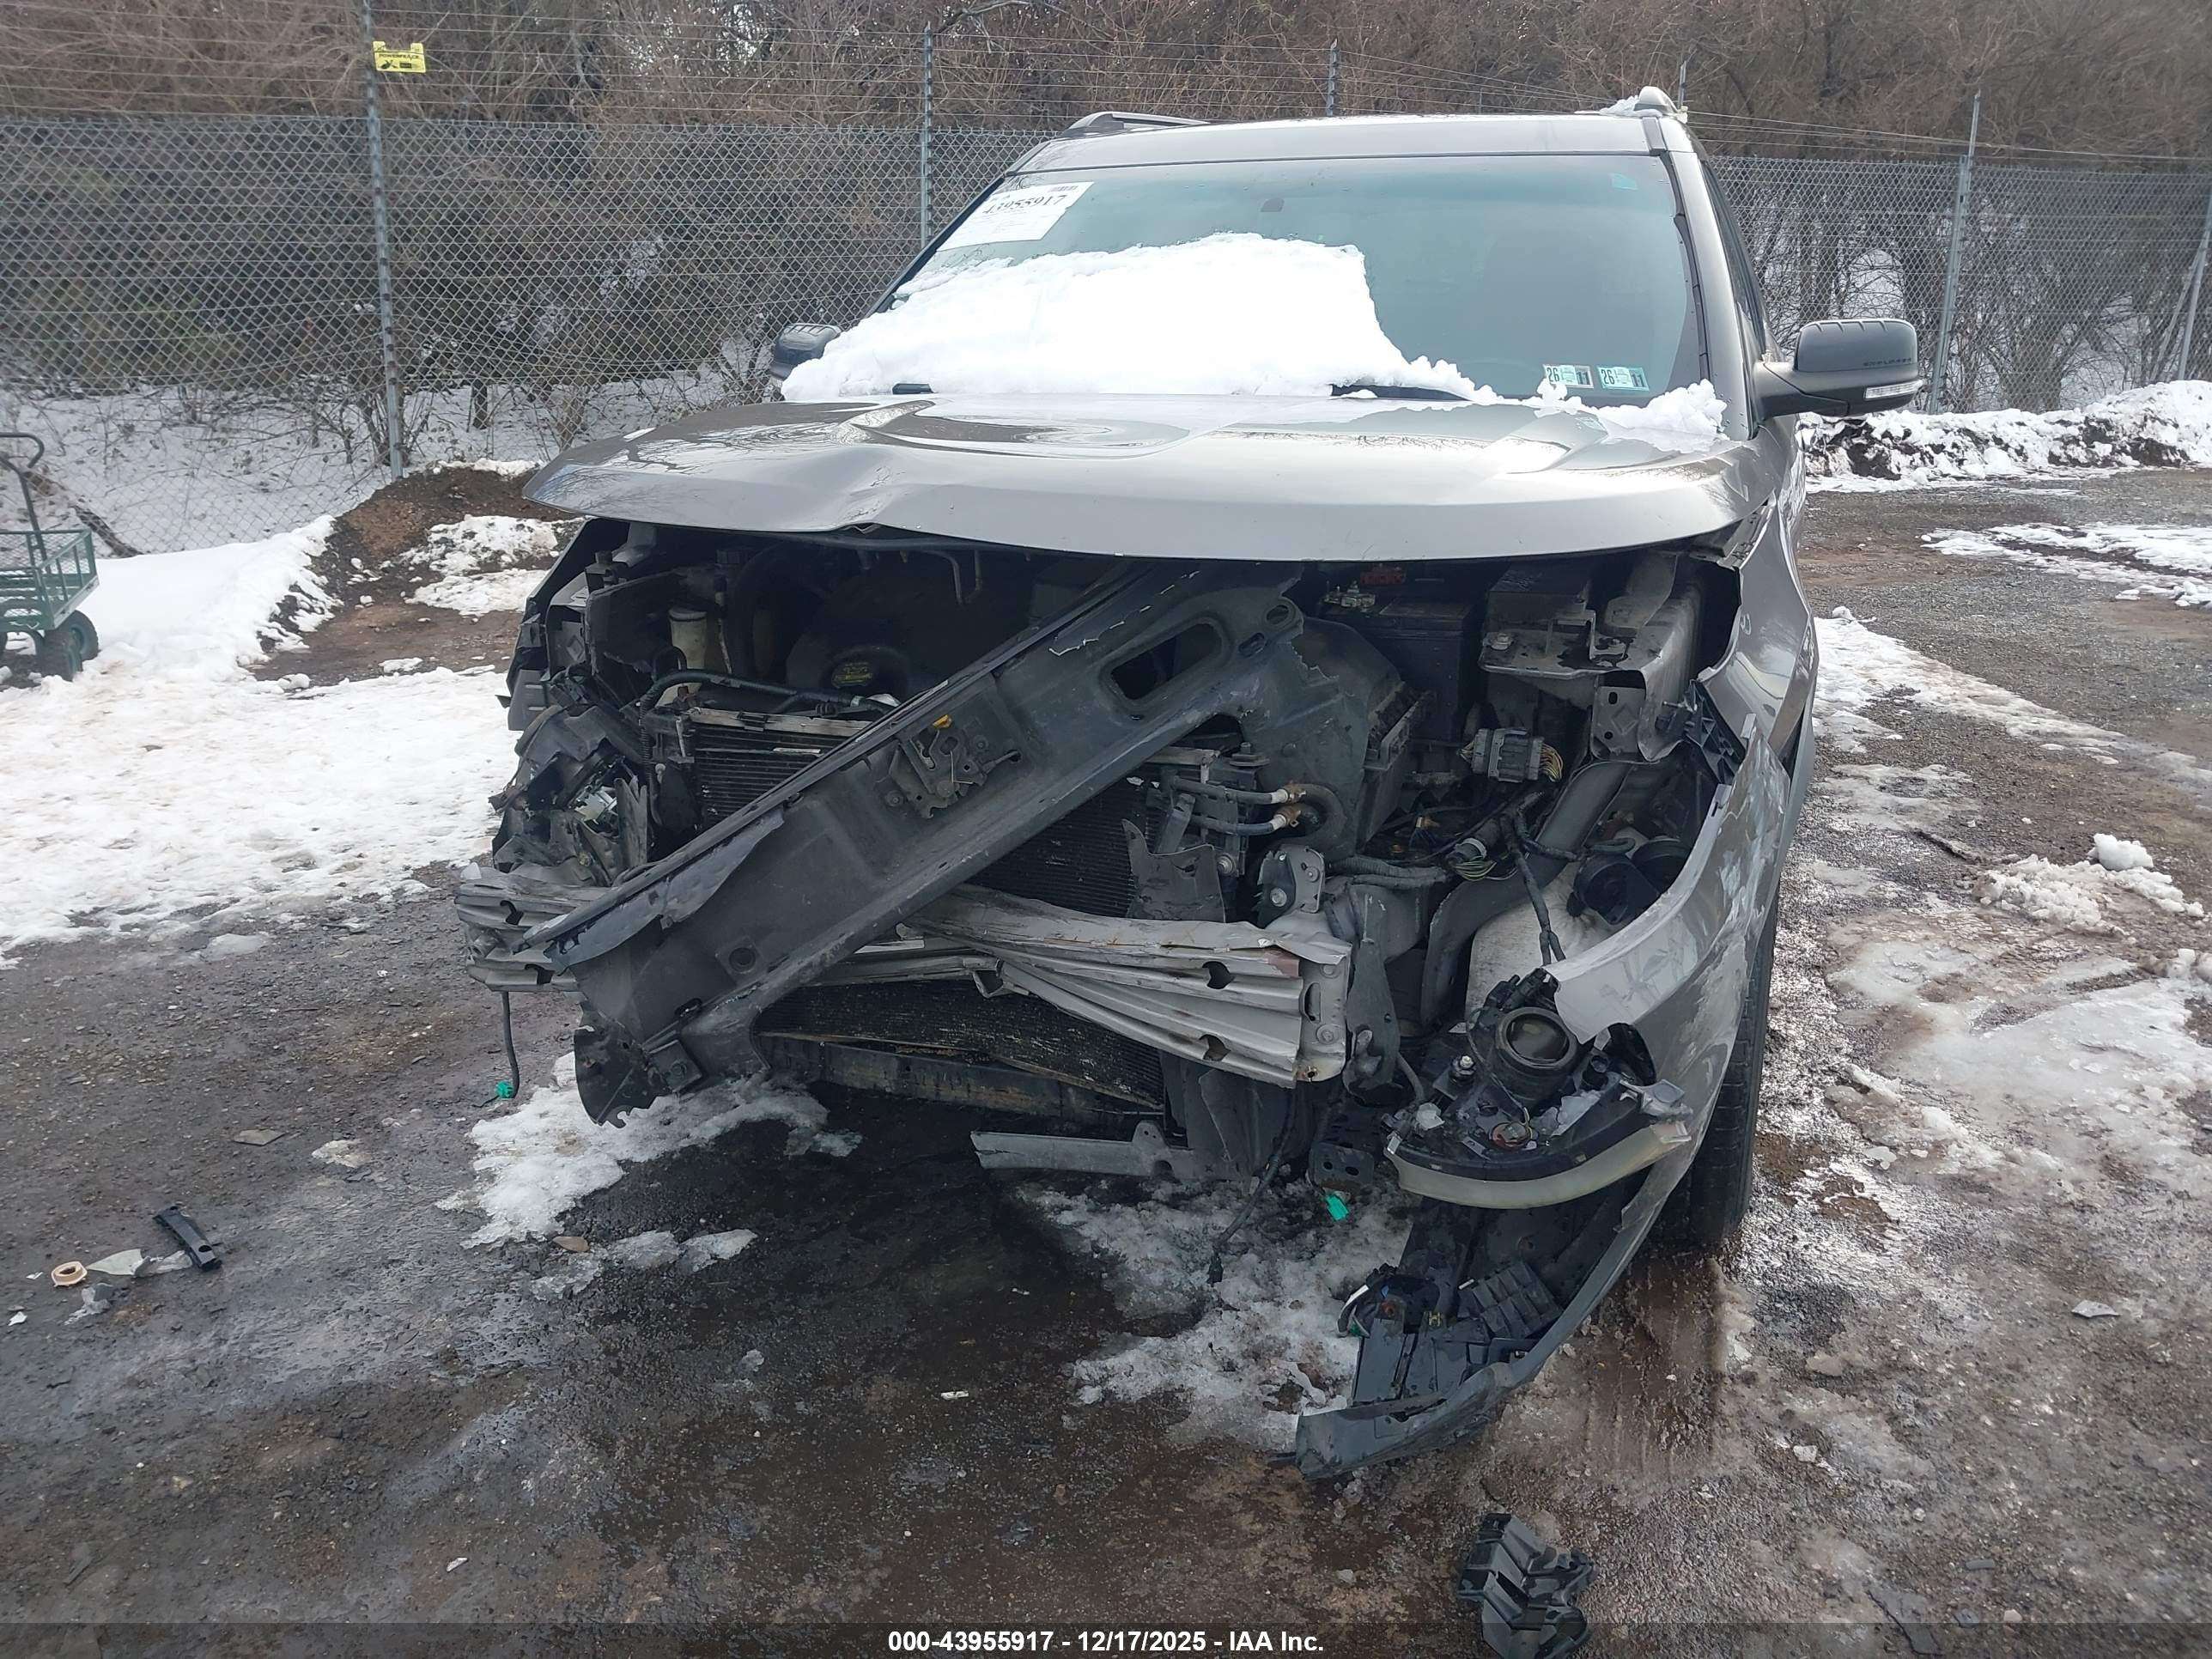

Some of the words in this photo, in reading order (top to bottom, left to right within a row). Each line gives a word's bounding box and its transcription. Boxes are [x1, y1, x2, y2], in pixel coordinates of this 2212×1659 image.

[1547, 367, 1560, 382] 26
[1576, 371, 1591, 385] 11
[1601, 368, 1615, 384] 26
[1631, 374, 1646, 387] 11
